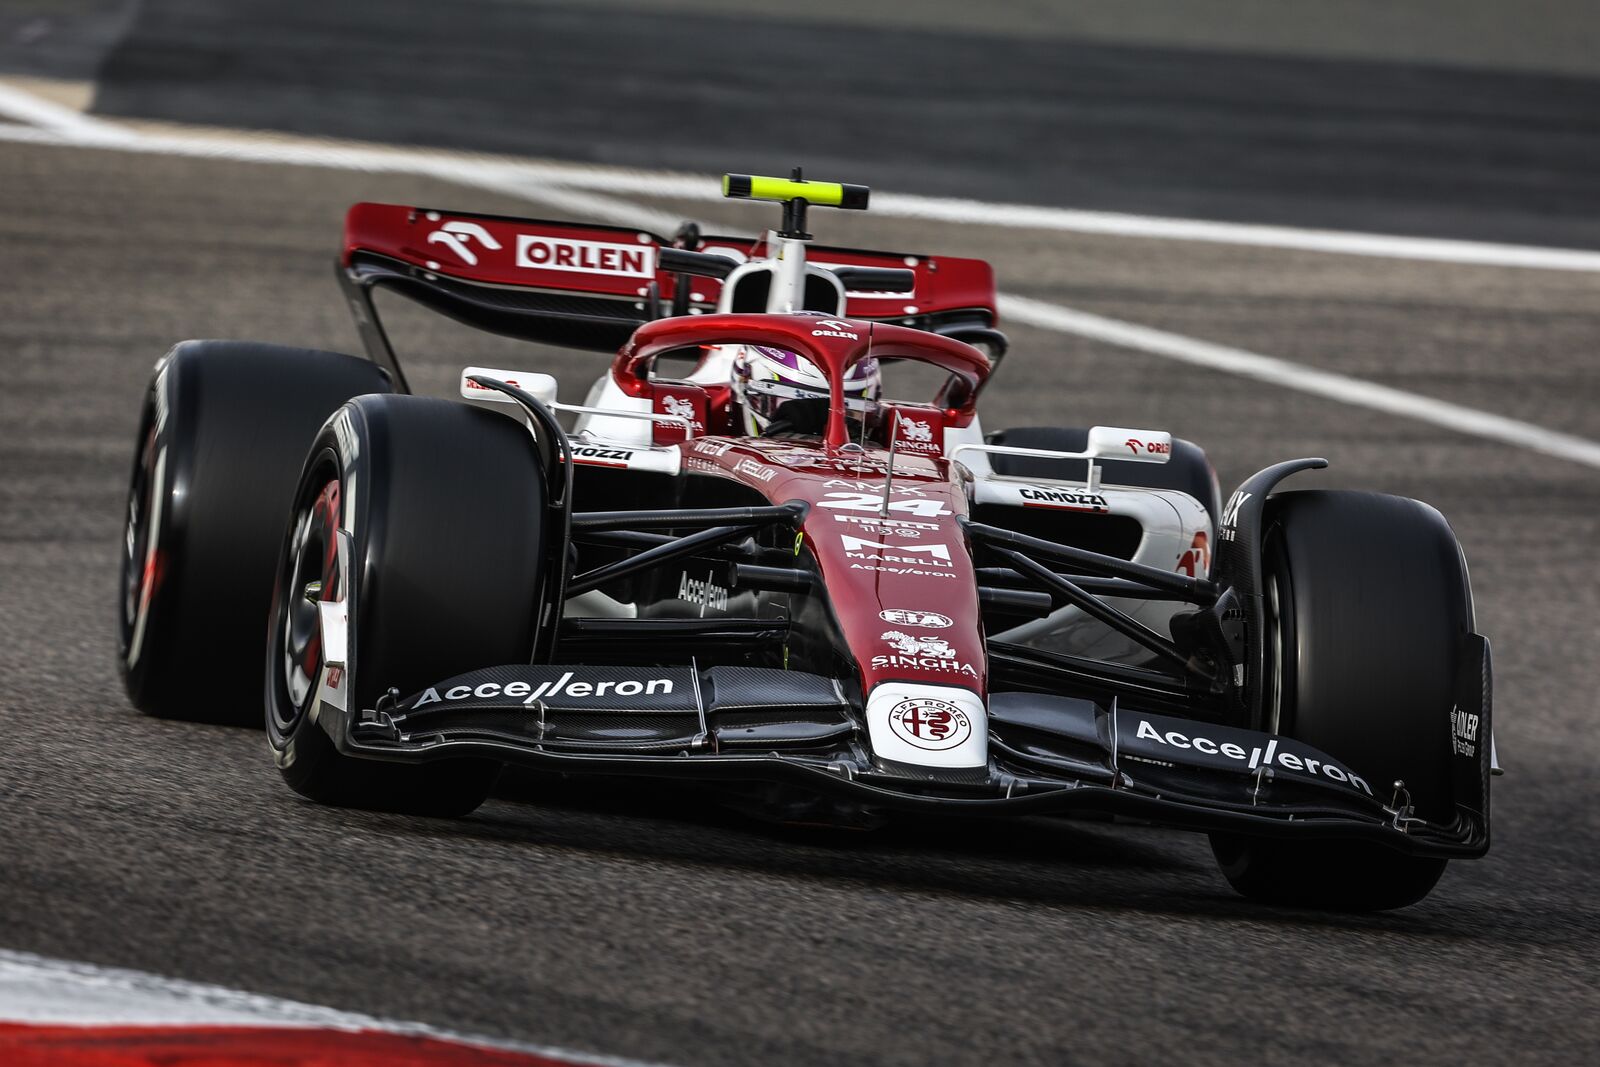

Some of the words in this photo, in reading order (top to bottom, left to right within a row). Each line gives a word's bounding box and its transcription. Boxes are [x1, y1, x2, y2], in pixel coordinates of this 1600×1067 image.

[526, 241, 645, 273] ORLEN
[811, 329, 858, 340] ORLEN
[570, 446, 634, 460] MOZZI
[894, 440, 941, 451] SINGHA
[816, 492, 953, 517] 24
[1019, 488, 1108, 506] CAMOZZI
[845, 552, 953, 567] MARELLI
[850, 563, 957, 578] Accelleron
[678, 570, 727, 618] Accelleron
[884, 610, 949, 627] FIA
[872, 656, 978, 676] SINGHA
[411, 672, 674, 710] Accelleron
[892, 701, 917, 720] ALFA
[924, 701, 967, 727] ROMEO
[1457, 710, 1478, 741] ADLER
[1136, 720, 1374, 797] Accelleron
